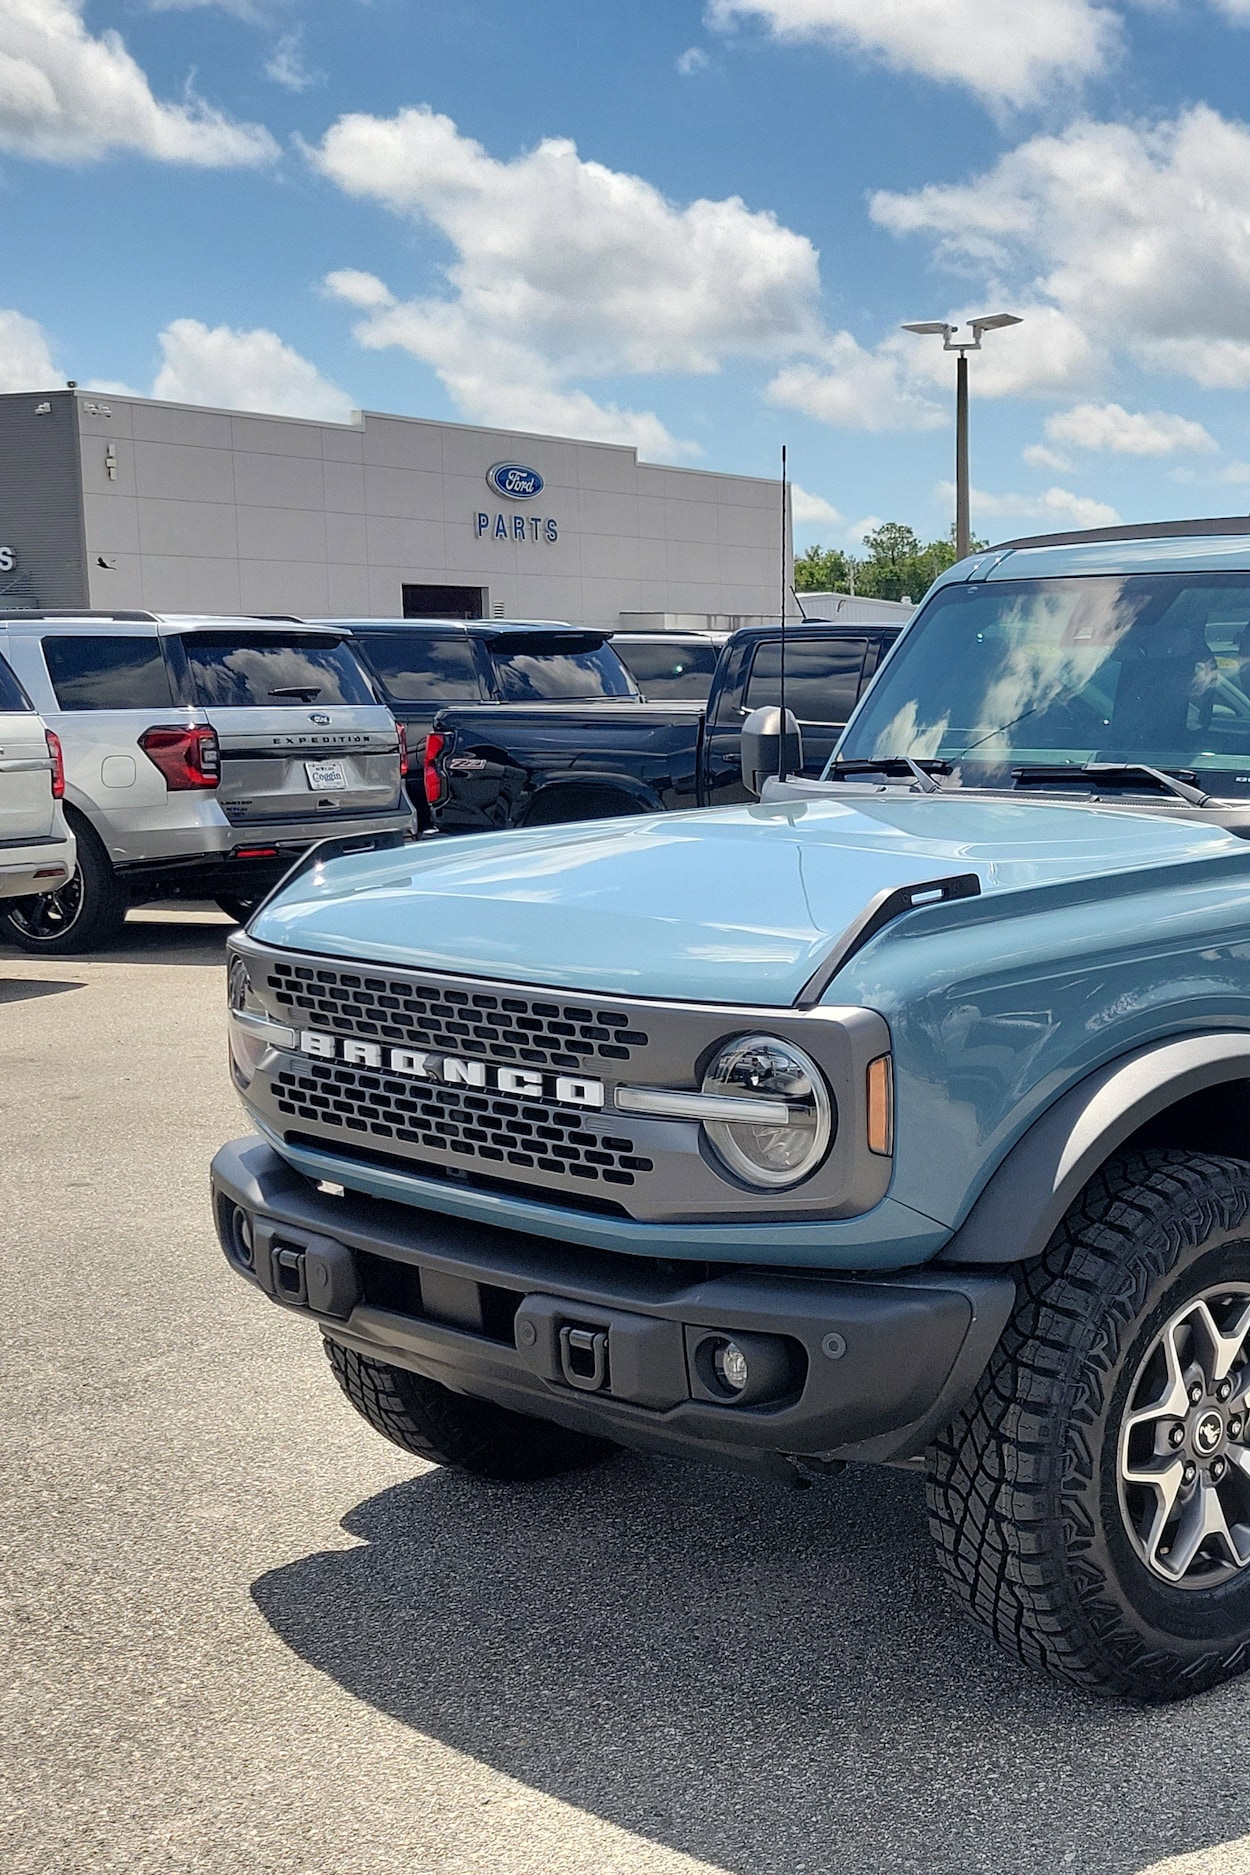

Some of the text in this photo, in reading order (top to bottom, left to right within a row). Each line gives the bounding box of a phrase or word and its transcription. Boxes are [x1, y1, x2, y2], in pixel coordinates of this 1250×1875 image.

[505, 470, 535, 493] Ford
[477, 512, 558, 542] PARTS
[273, 735, 370, 745] EXPEDITION
[312, 771, 342, 782] Coggin
[300, 1030, 605, 1107] BRONCO
